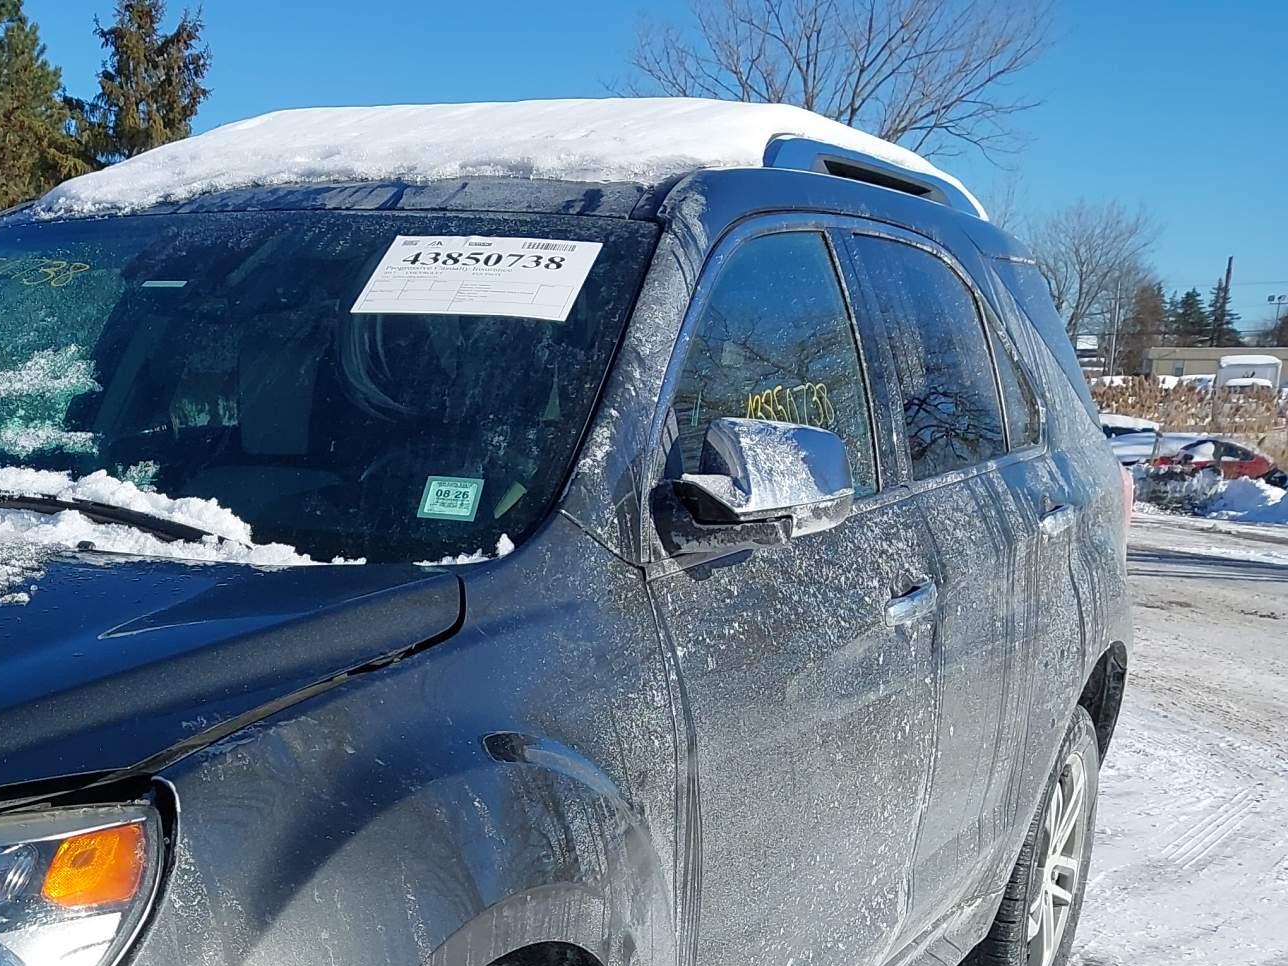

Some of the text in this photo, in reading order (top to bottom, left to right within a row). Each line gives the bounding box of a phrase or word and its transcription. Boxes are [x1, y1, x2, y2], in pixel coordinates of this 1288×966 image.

[402, 251, 566, 270] 43850738
[436, 489, 470, 499] 08 26
